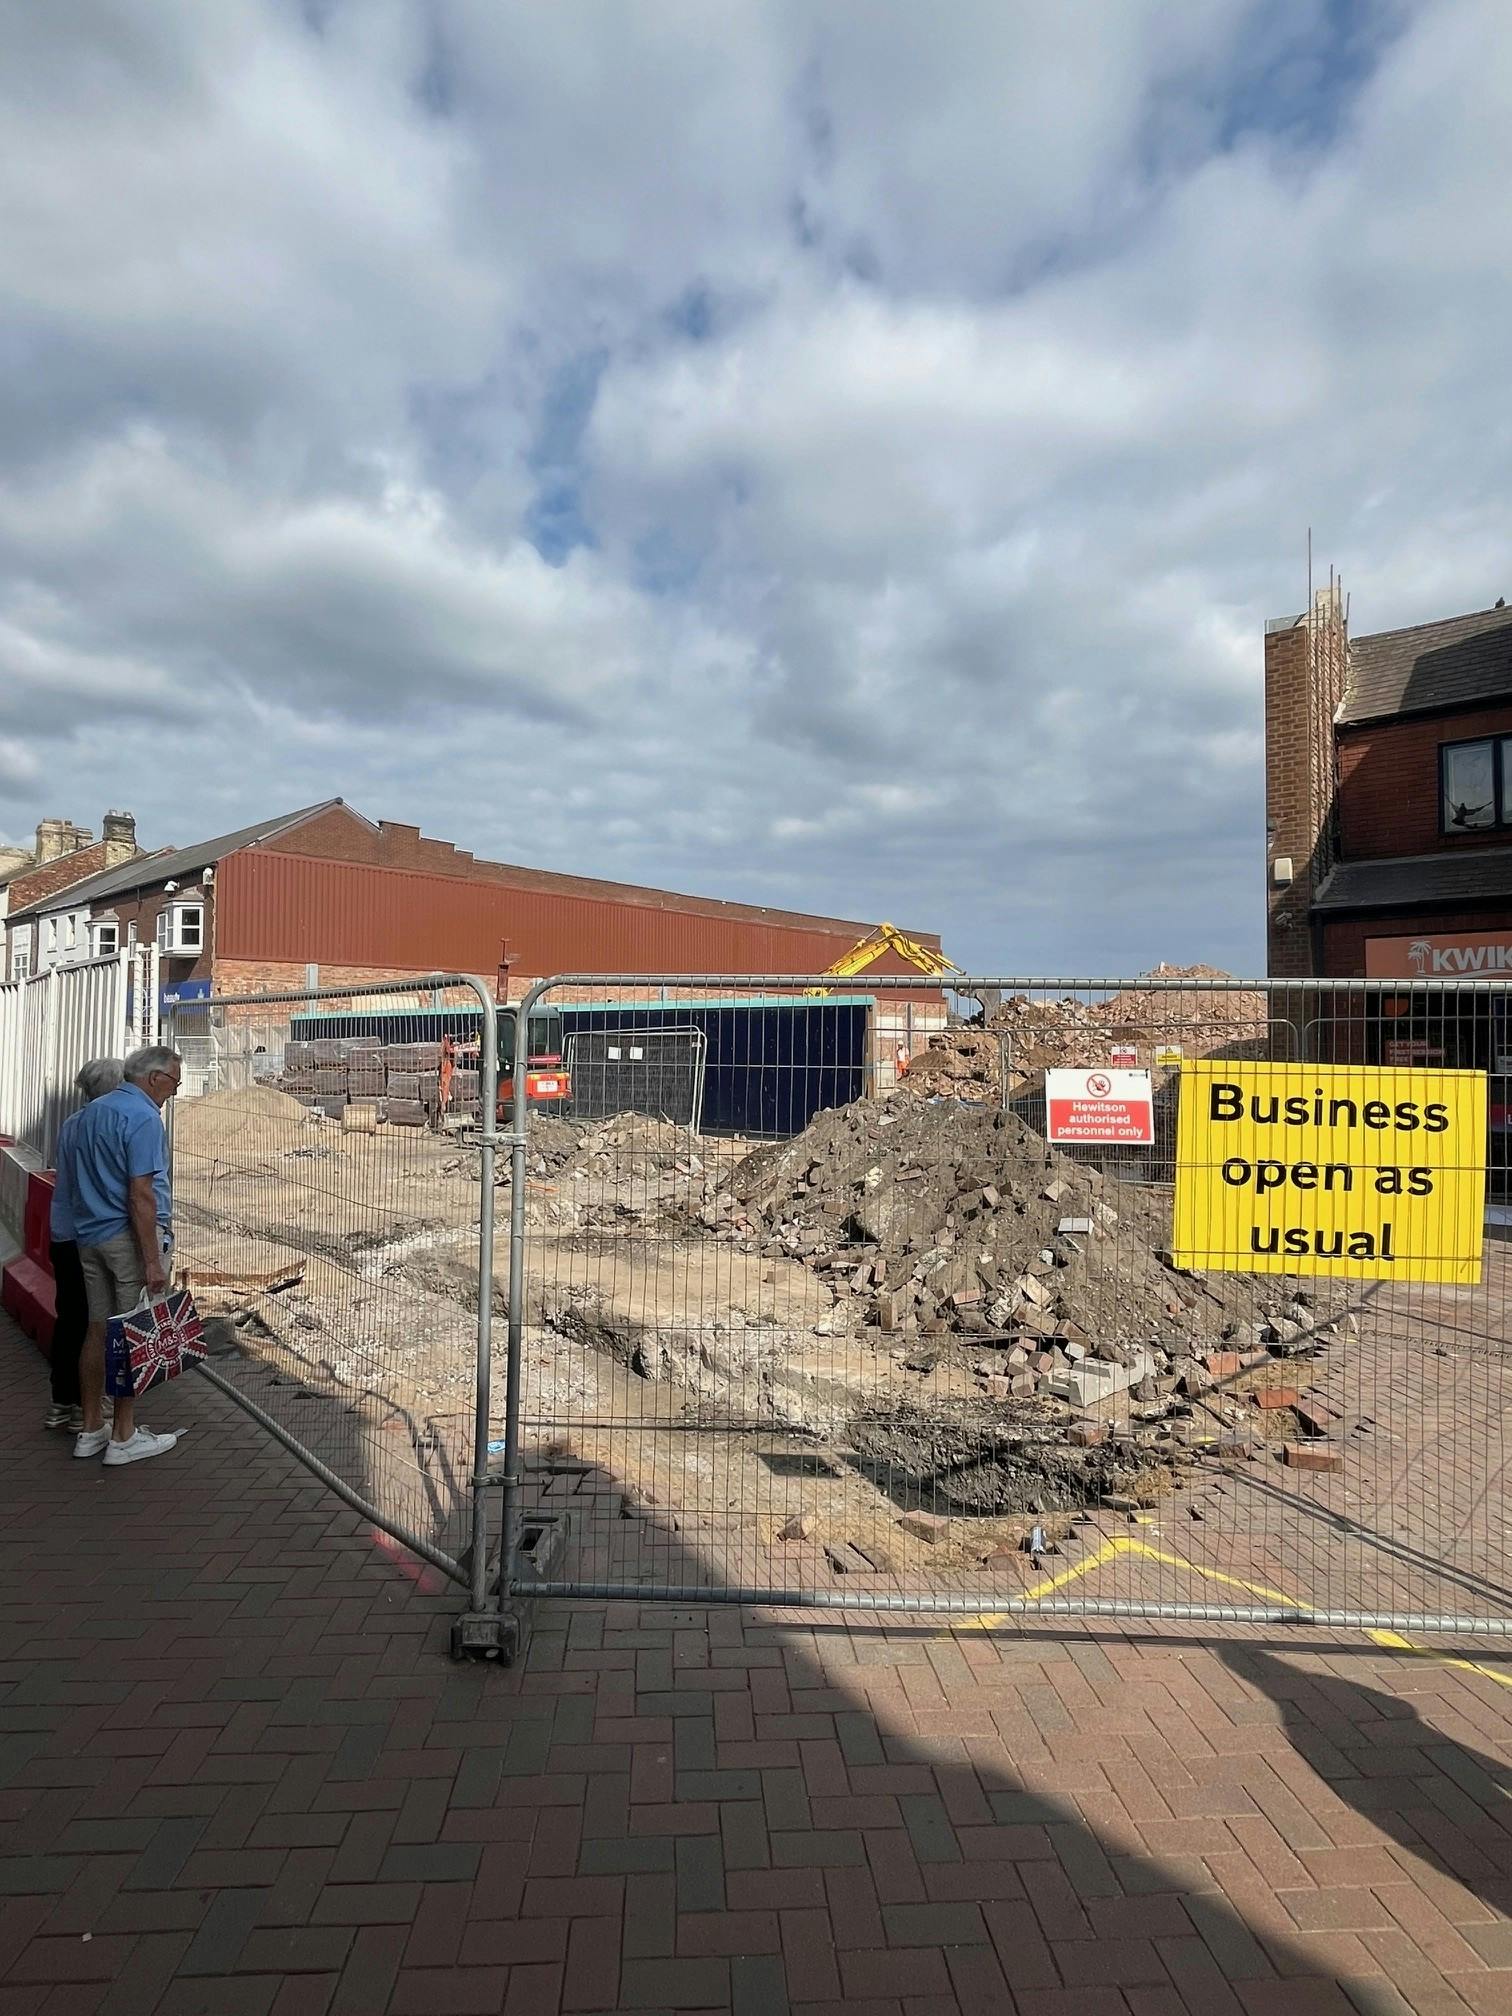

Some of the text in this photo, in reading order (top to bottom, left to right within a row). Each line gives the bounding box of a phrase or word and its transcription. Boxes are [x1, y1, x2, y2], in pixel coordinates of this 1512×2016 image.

[1432, 946, 1512, 972] KWIK
[1072, 1101, 1126, 1112] Hewitson
[1210, 1083, 1449, 1132] Business
[1069, 1113, 1131, 1124] authorised
[1057, 1126, 1143, 1138] personnel only
[1221, 1157, 1433, 1196] open as
[1251, 1223, 1395, 1261] usual
[158, 1332, 178, 1350] M&S
